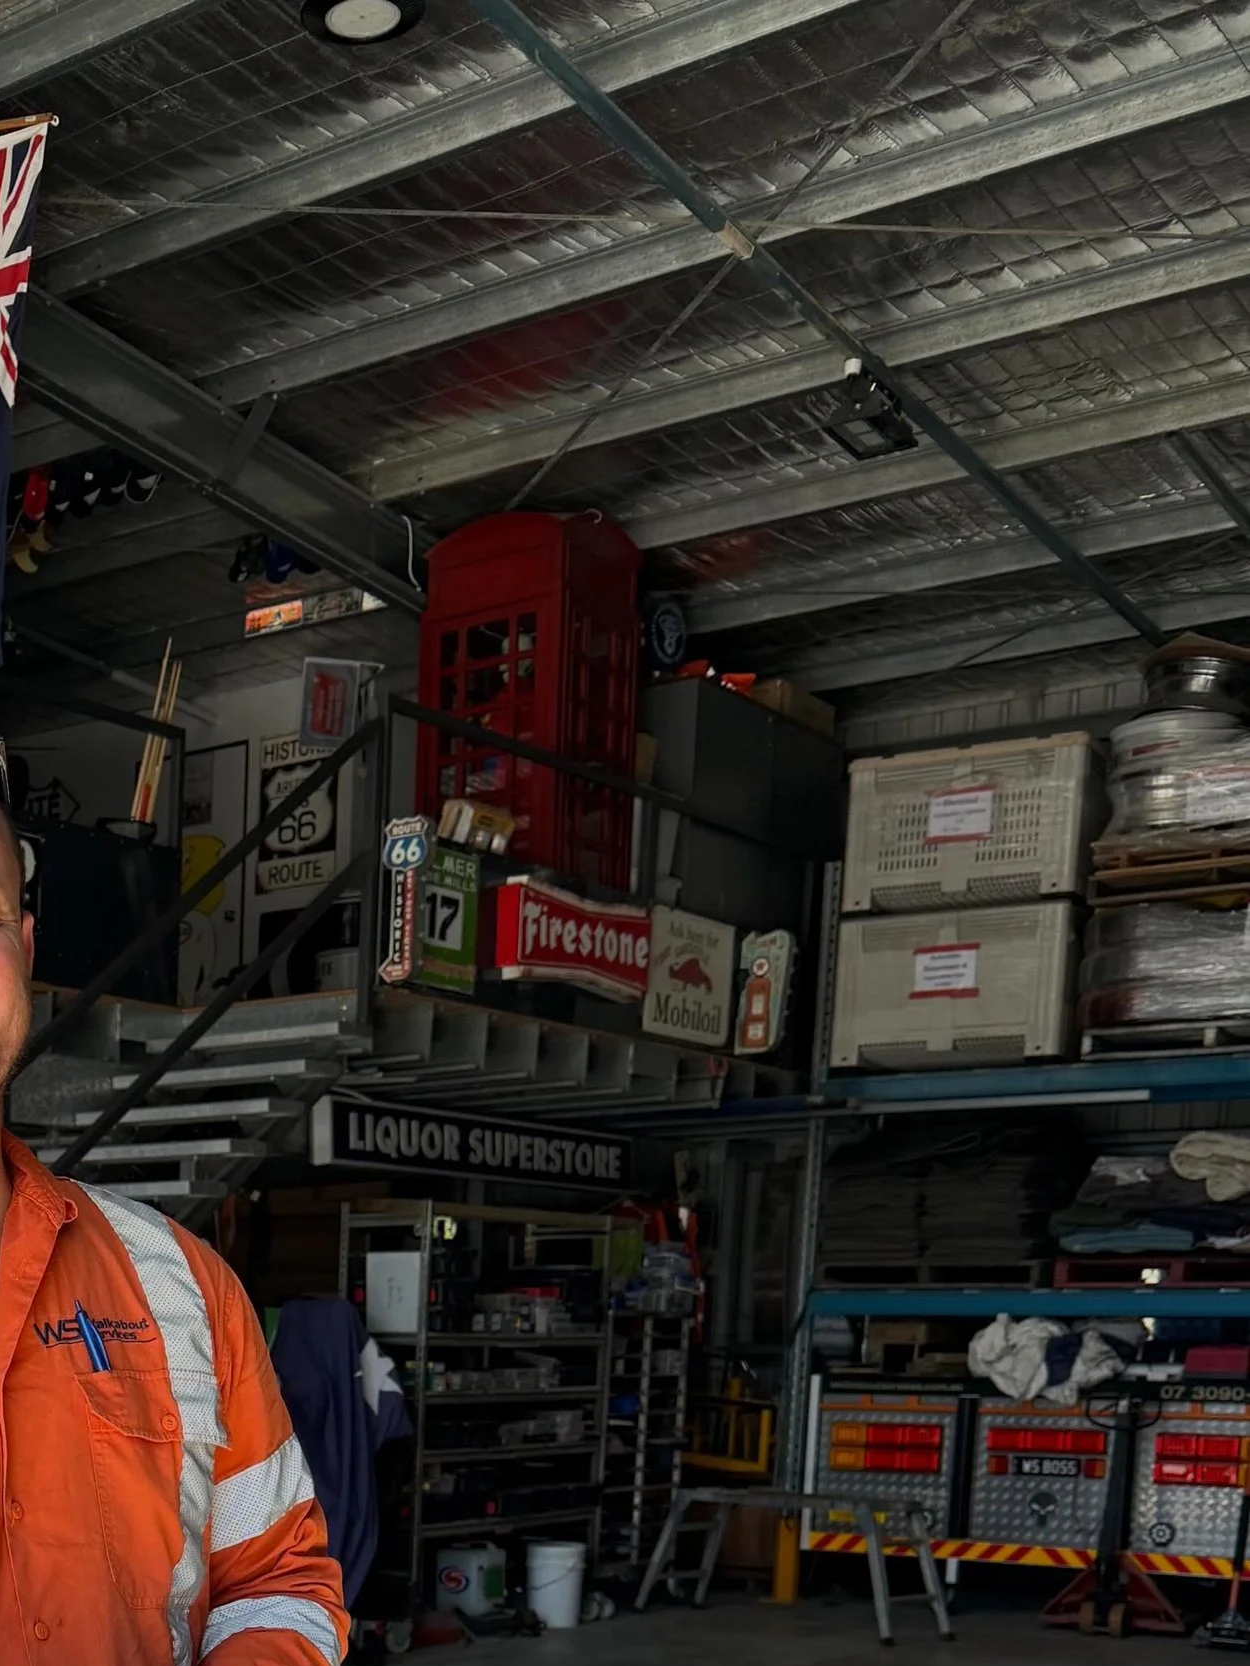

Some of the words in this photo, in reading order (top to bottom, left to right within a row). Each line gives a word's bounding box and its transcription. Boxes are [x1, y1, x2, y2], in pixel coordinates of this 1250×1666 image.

[278, 811, 317, 844] 66
[391, 822, 423, 835] ROUTE
[390, 836, 421, 865] 66
[267, 859, 323, 885] ROUTE
[393, 872, 405, 963] HISTORIC
[426, 892, 459, 941] 17
[523, 900, 649, 969] Firestone
[652, 991, 723, 1035] Mobiloil
[348, 1110, 461, 1161] LIQUOR
[468, 1127, 622, 1180] SUPERSTORE
[33, 1317, 82, 1346] WS
[102, 1329, 138, 1340] rvices
[1159, 1384, 1187, 1400] 07
